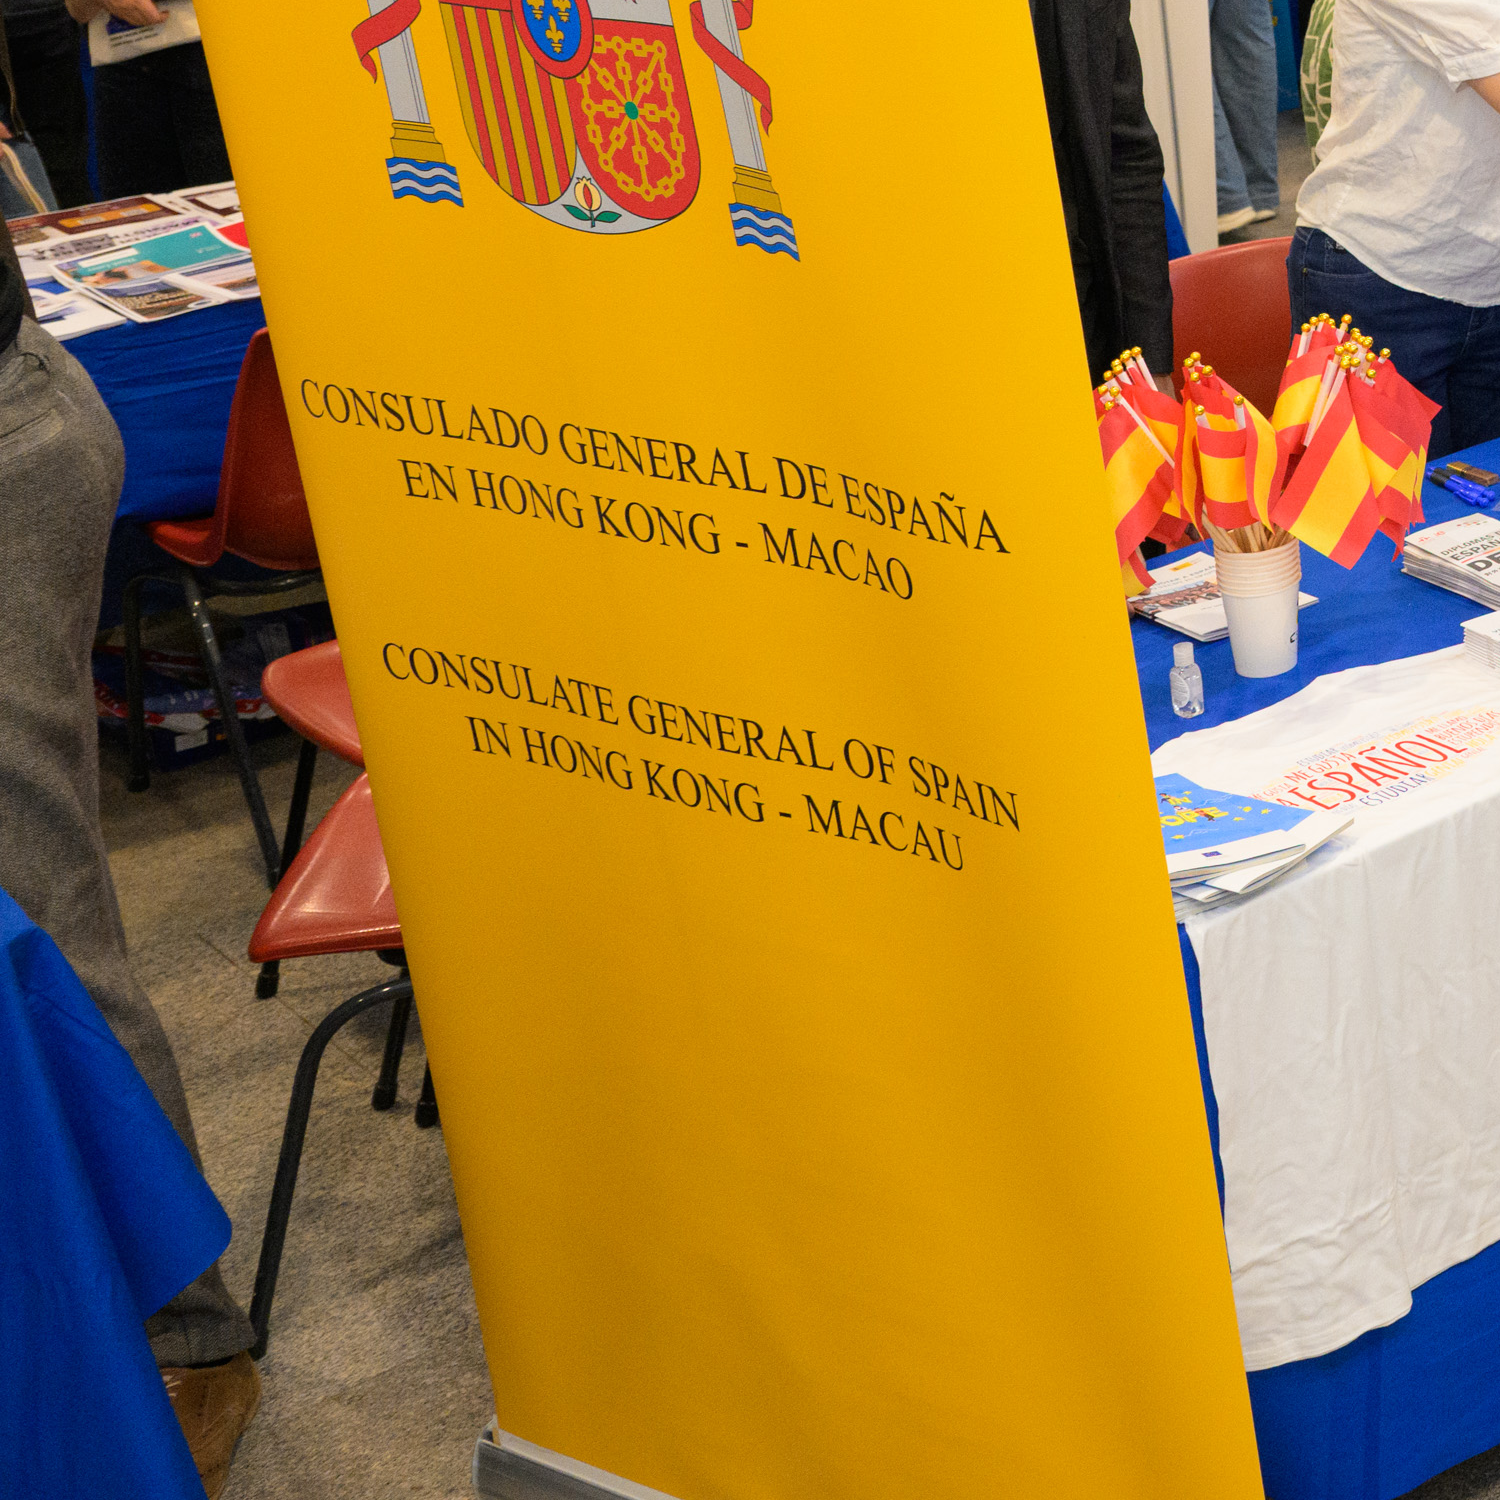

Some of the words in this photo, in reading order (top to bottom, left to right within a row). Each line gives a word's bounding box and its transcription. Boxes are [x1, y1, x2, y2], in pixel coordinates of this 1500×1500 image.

[300, 378, 549, 456] CONSULADO
[558, 423, 768, 494] GENERAL
[772, 456, 835, 509] DE
[837, 472, 1011, 555] ESPAÑA
[398, 458, 459, 504] EN
[470, 468, 584, 530] HONG
[591, 492, 722, 555] KONG
[757, 521, 914, 601] MACAO
[1440, 533, 1495, 556] DIPLOMAS
[381, 641, 619, 726] CONSULATE
[627, 694, 835, 772] GENERAL
[843, 738, 896, 785] OF
[907, 755, 1021, 833] SPAIN
[1284, 770, 1314, 784] ME
[1307, 751, 1357, 775] GUSTA
[1287, 734, 1468, 810] ESPAÑOL
[1359, 773, 1434, 807] ESTUDIAR
[464, 714, 513, 760] IN
[517, 723, 634, 791] HONG
[638, 757, 766, 824] KONG
[801, 792, 964, 871] MACAU
